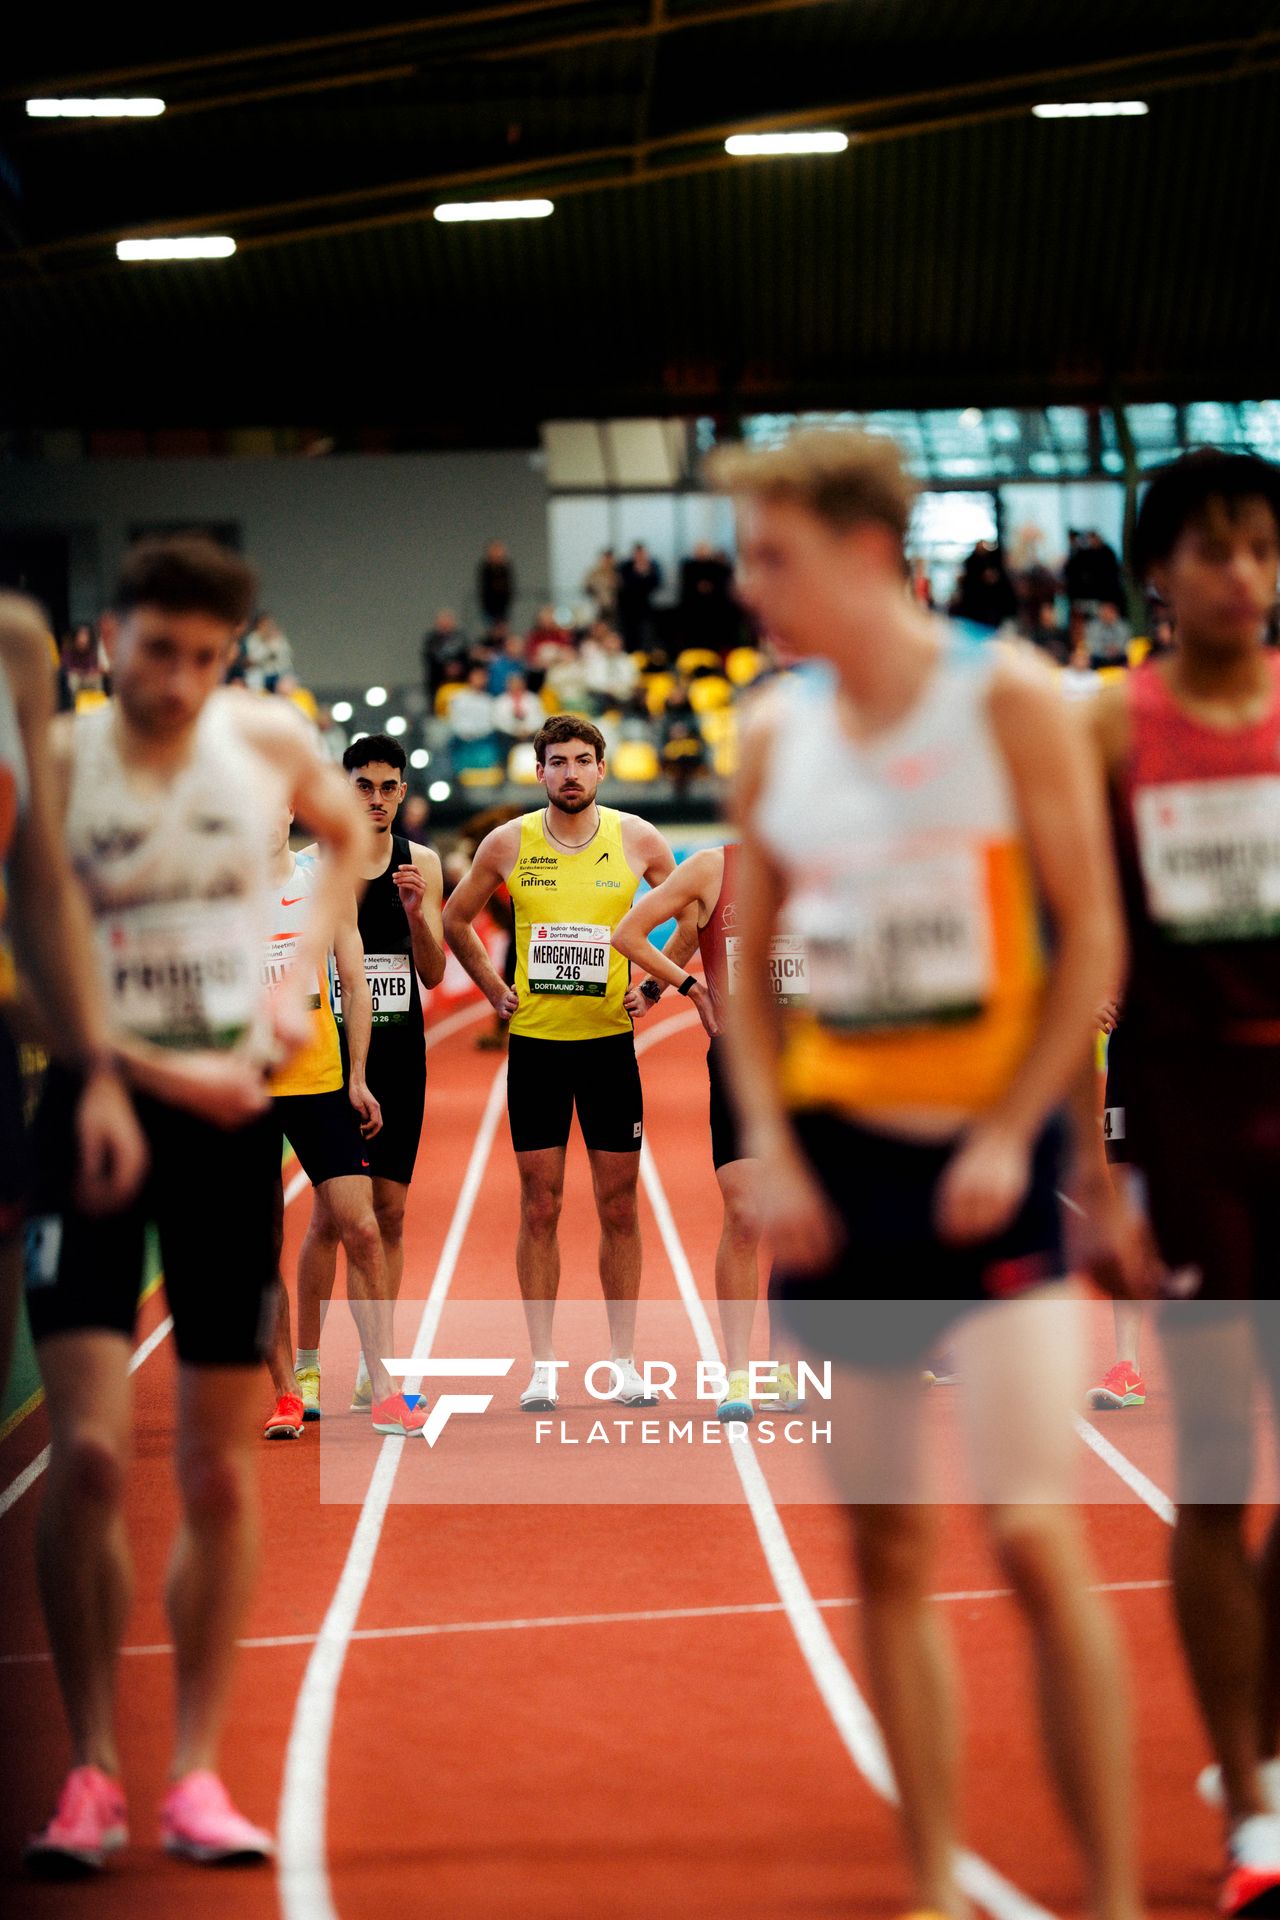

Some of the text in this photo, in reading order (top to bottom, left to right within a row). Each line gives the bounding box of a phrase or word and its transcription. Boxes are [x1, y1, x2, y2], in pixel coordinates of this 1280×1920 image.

[521, 877, 556, 887] infinex
[533, 945, 605, 967] MERGENTHALER
[556, 965, 581, 980] 246
[534, 983, 574, 991] DORTMUND
